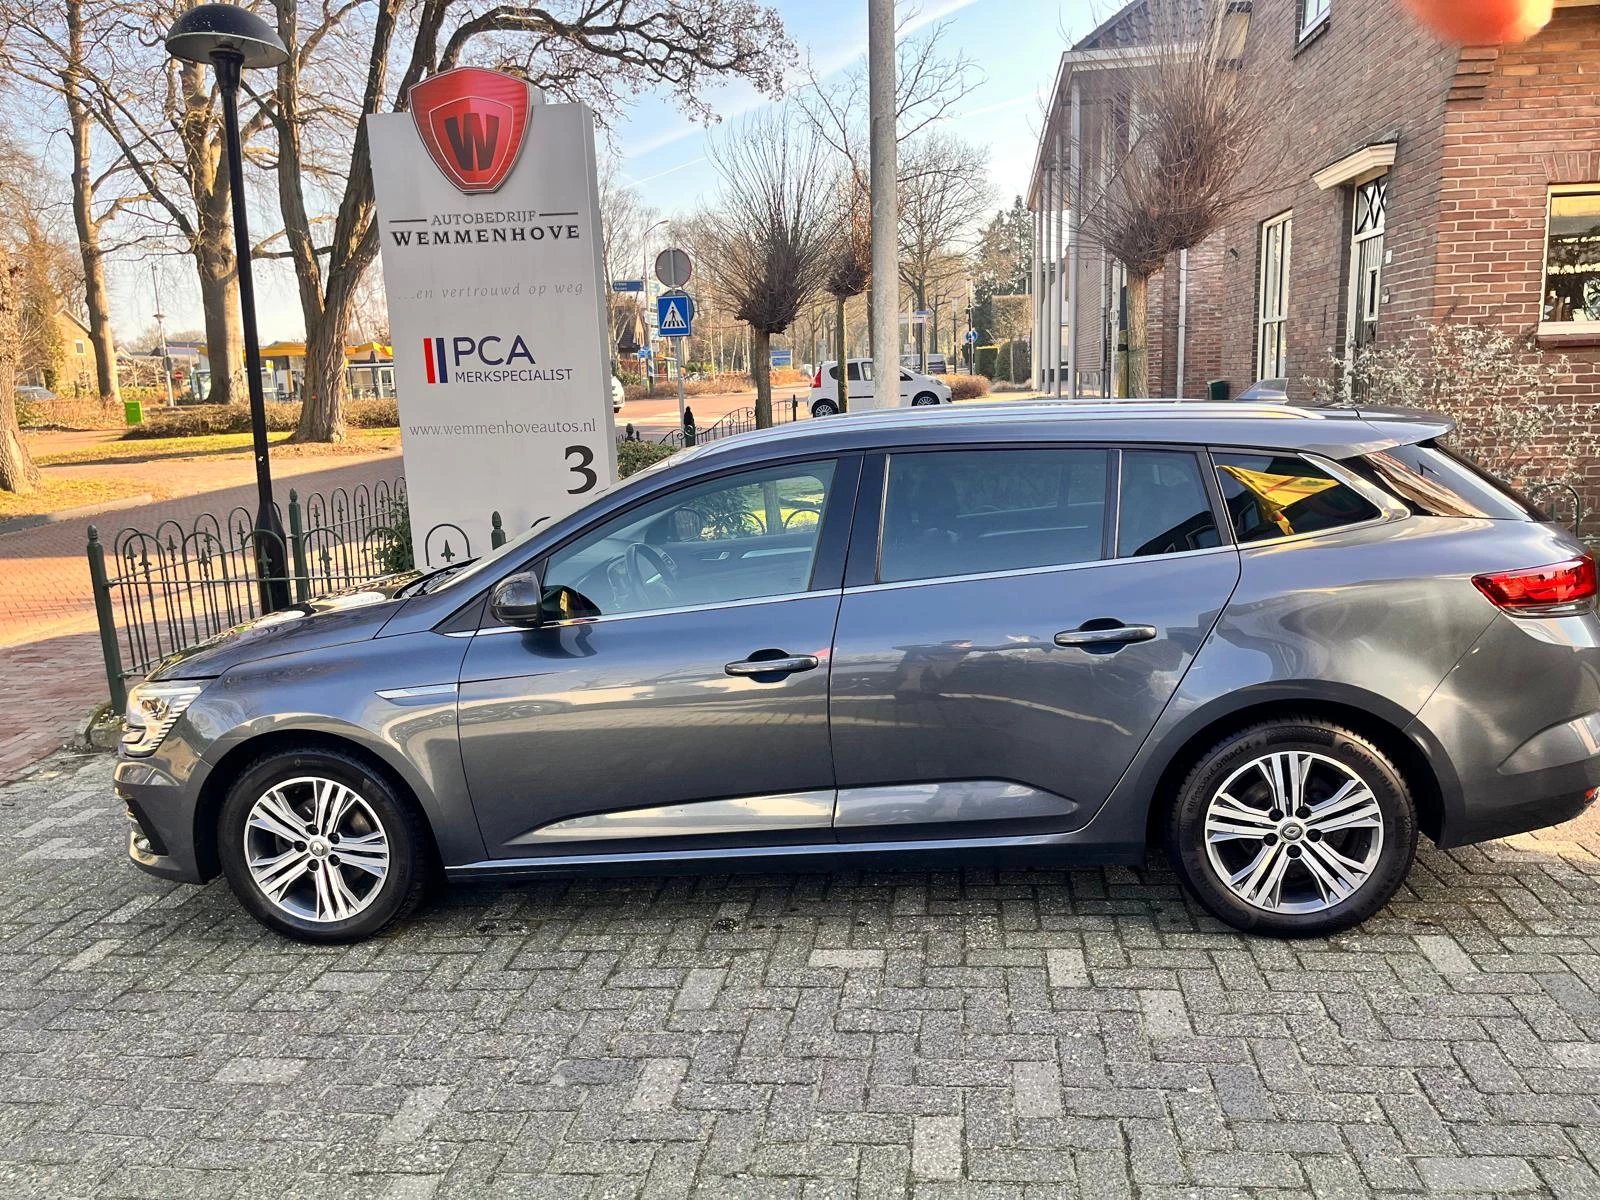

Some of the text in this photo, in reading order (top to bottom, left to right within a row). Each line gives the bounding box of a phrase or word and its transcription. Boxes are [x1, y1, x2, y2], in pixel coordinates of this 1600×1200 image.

[444, 112, 500, 172] W
[431, 210, 537, 226] AUTOBEDRIJF
[391, 225, 580, 246] WEMMENHOVE
[442, 283, 520, 298] vertrouwd
[528, 284, 547, 296] op
[554, 282, 583, 296] weg
[453, 334, 536, 367] PCA
[455, 368, 573, 383] MERKSPECIALIST
[409, 418, 596, 436] www.wemmenhoveautos.nl
[564, 444, 598, 495] 3
